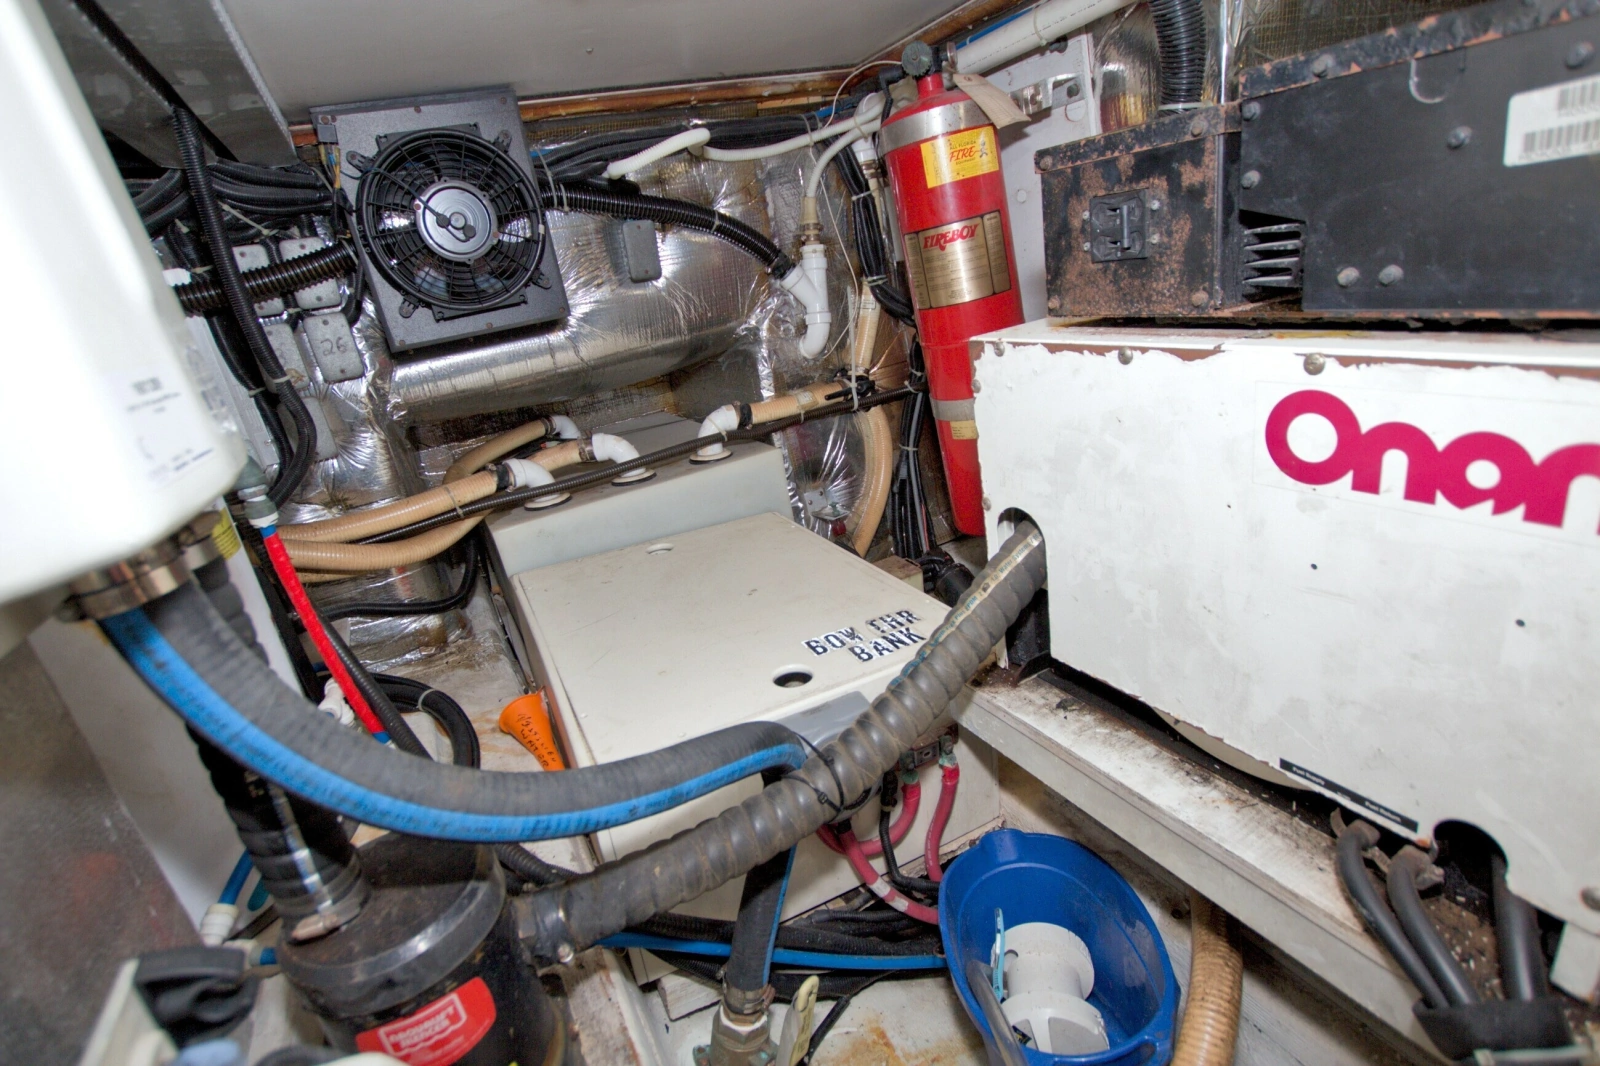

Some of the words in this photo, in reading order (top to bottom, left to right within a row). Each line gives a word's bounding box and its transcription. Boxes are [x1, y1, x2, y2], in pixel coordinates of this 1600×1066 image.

[949, 146, 977, 162] FIRE
[923, 223, 979, 251] FIREBOY
[320, 336, 347, 356] 26
[1265, 389, 1600, 536] Onan
[804, 627, 863, 656] BOW
[848, 627, 927, 662] BANK
[521, 728, 549, 767] WATER
